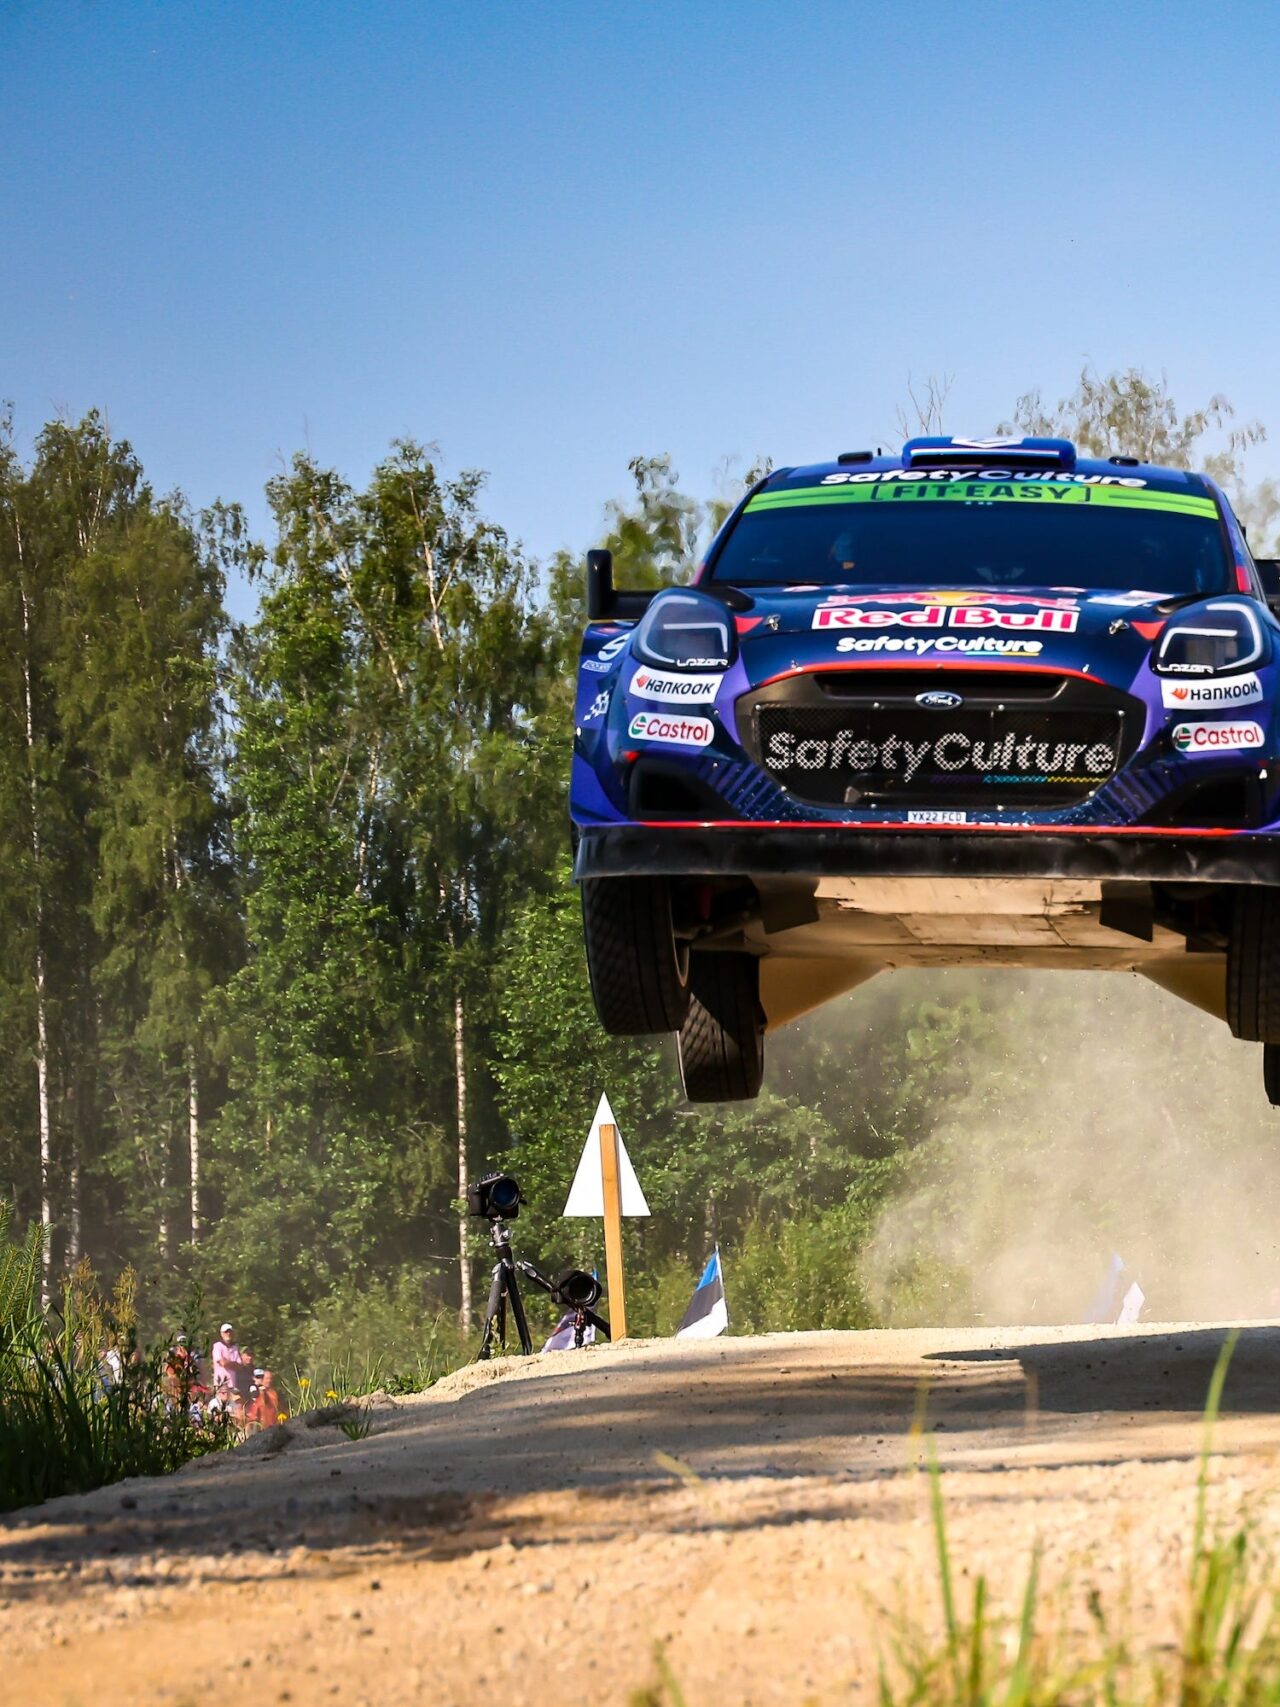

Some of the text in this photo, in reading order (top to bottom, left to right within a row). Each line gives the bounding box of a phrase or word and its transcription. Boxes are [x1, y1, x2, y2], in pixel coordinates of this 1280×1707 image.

[820, 469, 1147, 487] SafetyCulture
[813, 606, 1080, 632] Red Bull
[836, 636, 1043, 655] SafetyCulture
[646, 719, 709, 741] Castrol
[1194, 727, 1259, 748] Castrol
[766, 729, 1114, 783] SafetyCulture
